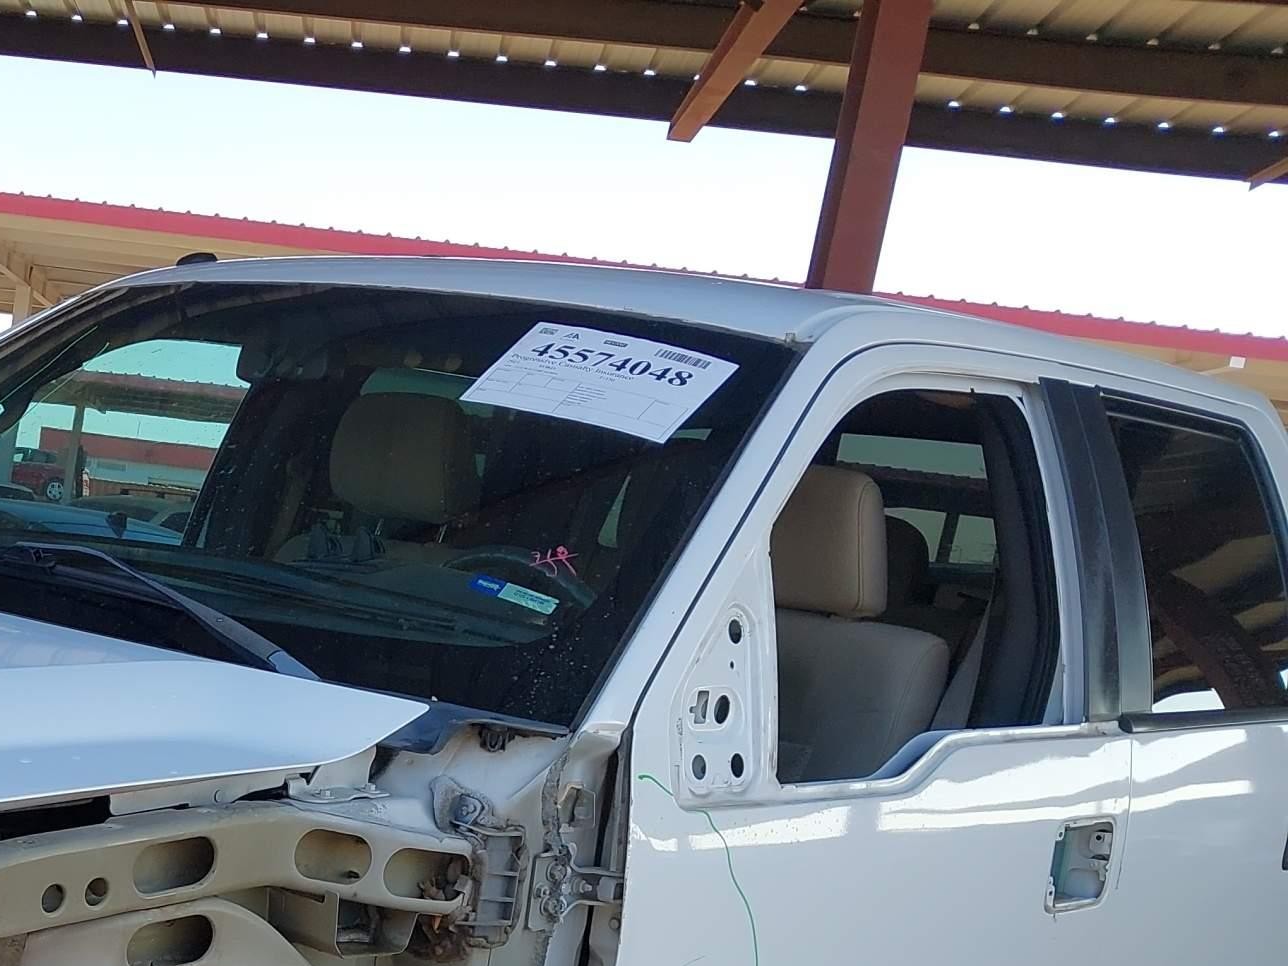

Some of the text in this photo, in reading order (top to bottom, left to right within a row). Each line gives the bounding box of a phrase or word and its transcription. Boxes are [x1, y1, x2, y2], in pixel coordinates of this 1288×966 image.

[531, 342, 694, 387] 45574048
[558, 360, 594, 373] Casualty
[595, 367, 636, 381] Insurance
